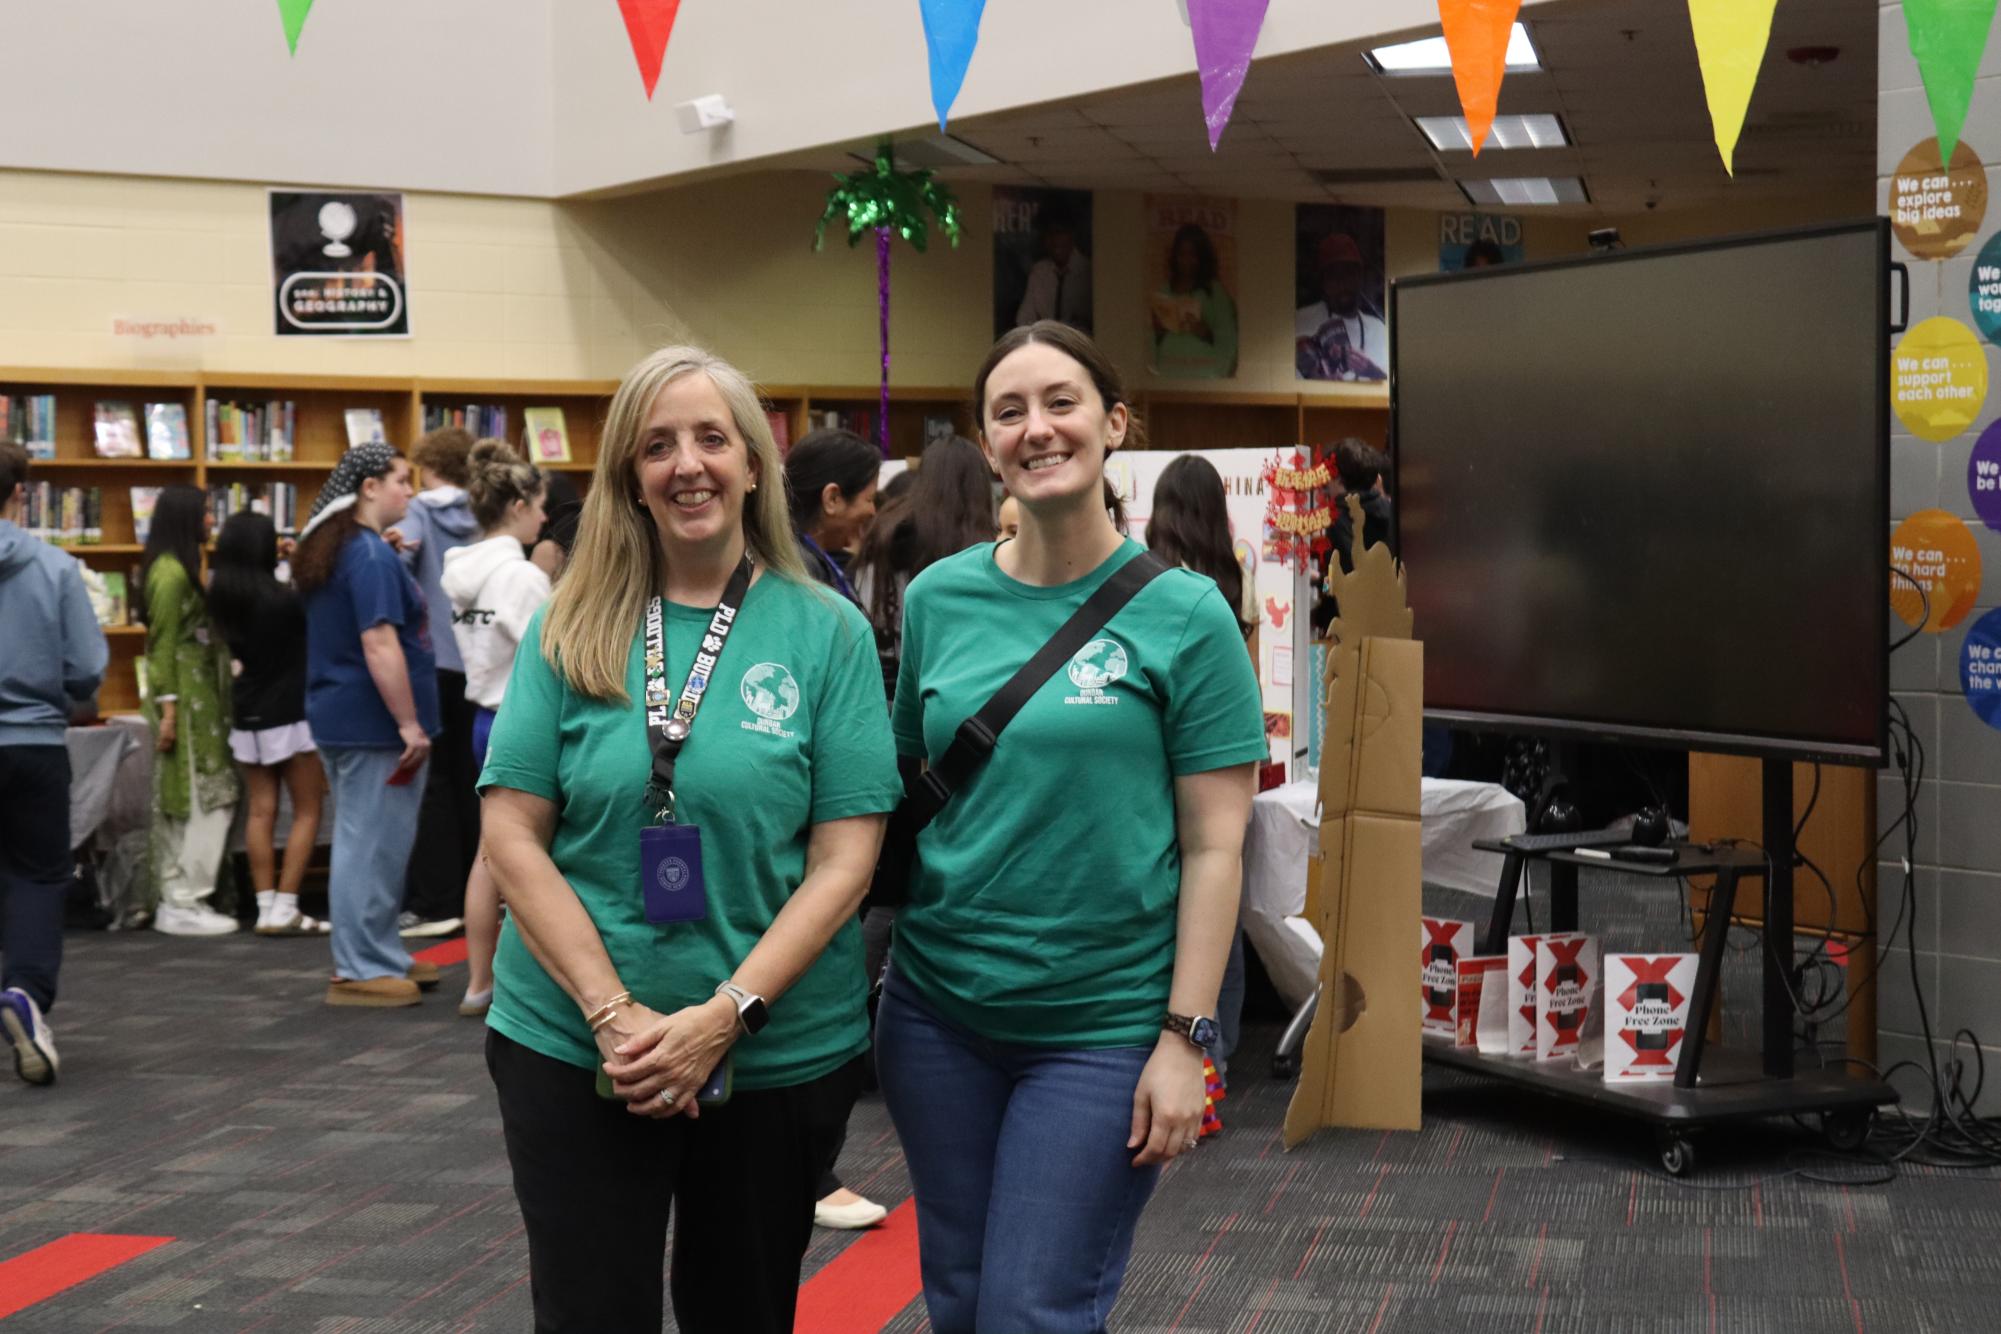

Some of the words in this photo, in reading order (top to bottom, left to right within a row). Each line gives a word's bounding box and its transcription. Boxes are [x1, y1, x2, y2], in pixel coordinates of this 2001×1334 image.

[1897, 177, 1918, 192] We
[1897, 191, 1952, 208] explore
[1897, 207, 1920, 224] big
[1923, 205, 1961, 220] ideas
[1441, 215, 1521, 245] READ
[1978, 265, 2000, 281] We
[323, 288, 375, 299] HISTORY
[378, 288, 388, 299] &
[293, 300, 389, 313] GEOGRAPHY
[114, 319, 216, 340] Biographies
[1897, 357, 1918, 371] We
[1898, 369, 1953, 389] support
[1898, 385, 1933, 401] each
[1936, 384, 1975, 399] other
[1977, 460, 1999, 475] We
[1223, 475, 1264, 496] HINA
[1977, 474, 1995, 490] be
[1893, 546, 1914, 561] We
[1912, 562, 1946, 577] hard
[709, 602, 736, 636] PLD
[1968, 644, 1990, 659] We
[1969, 674, 1992, 689] the
[1064, 696, 1093, 704] CULTURAL
[1094, 696, 1119, 704] SOCIETY
[741, 720, 770, 733] CULTURAL
[771, 726, 794, 738] SOCIETY
[1441, 975, 1456, 986] Zon
[1556, 986, 1579, 997] Phone
[1550, 999, 1566, 1009] Free
[1567, 996, 1585, 1005] Zone
[1635, 1005, 1670, 1015] Phone
[1625, 1017, 1650, 1026] Free
[1652, 1017, 1680, 1026] Zone
